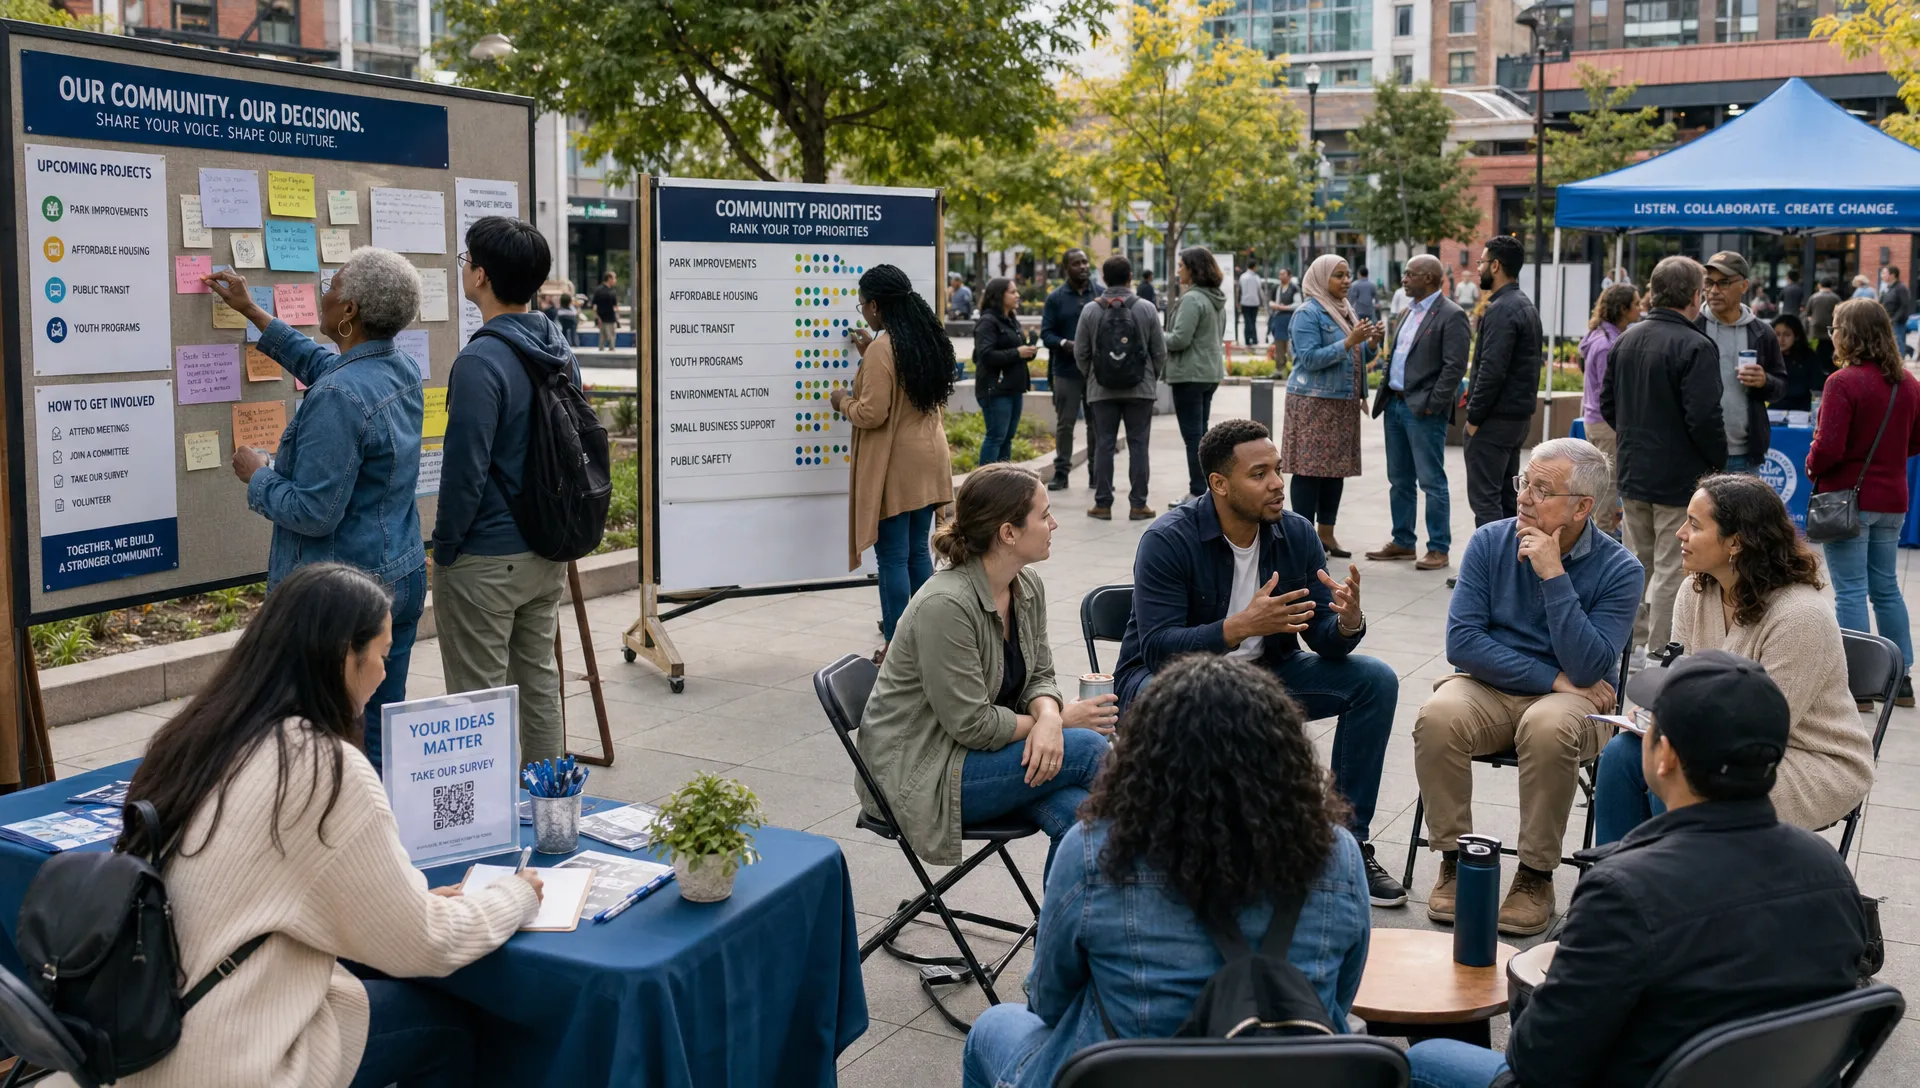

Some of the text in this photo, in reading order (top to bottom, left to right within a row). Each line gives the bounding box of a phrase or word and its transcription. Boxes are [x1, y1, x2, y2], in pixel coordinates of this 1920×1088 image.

[59, 75, 364, 133] OUR COMMUNITY. OUR DECISIONS.
[96, 112, 338, 148] SHARE YOUR VOICE. SHAPE OUR FUTURE.
[37, 159, 152, 179] UPCOMING PROJECTS
[70, 204, 149, 217] PARK IMPROVEMENTS
[716, 199, 882, 221] COMMUNITY PRIORITIES
[1634, 203, 1899, 215] LISTEN. COLLABORATE. CREATE CHANGE.
[730, 222, 869, 237] RANK YOUR TOP PRIORITIES
[71, 245, 150, 256] AFFORDABLE HOUSING
[669, 258, 757, 269] PARK IMPROVEMENTS
[72, 285, 130, 295] PUBLIC TRANSIT
[669, 290, 758, 301] AFFORDABLE HOUSING
[73, 322, 141, 333] YOUTH PROGRAMS
[670, 323, 735, 334] PUBLIC TRANSIT
[669, 356, 744, 367] YOUTH PROGRAMS
[670, 387, 769, 400] ENVIRONMENTAL ACTION
[48, 395, 155, 413] HOW TO GET INVOLVED
[69, 423, 130, 436] ATTEND MEETINGS
[670, 419, 776, 433] SMALL BUSINESS SUPPORT
[70, 446, 130, 460] JOIN A COMMITTEE
[670, 453, 732, 466] PUBLIC SAFETY
[70, 470, 129, 483] TAKE OUR SURVEY
[71, 495, 112, 507] VOLUNTEER
[66, 533, 155, 556] TOGETHER, WE BUILD
[59, 546, 163, 573] A STRONGER COMMUNITY.
[409, 712, 495, 738] YOUR IDEAS
[424, 733, 483, 755] MATTER
[410, 758, 494, 782] TAKE OUR SURVEY
